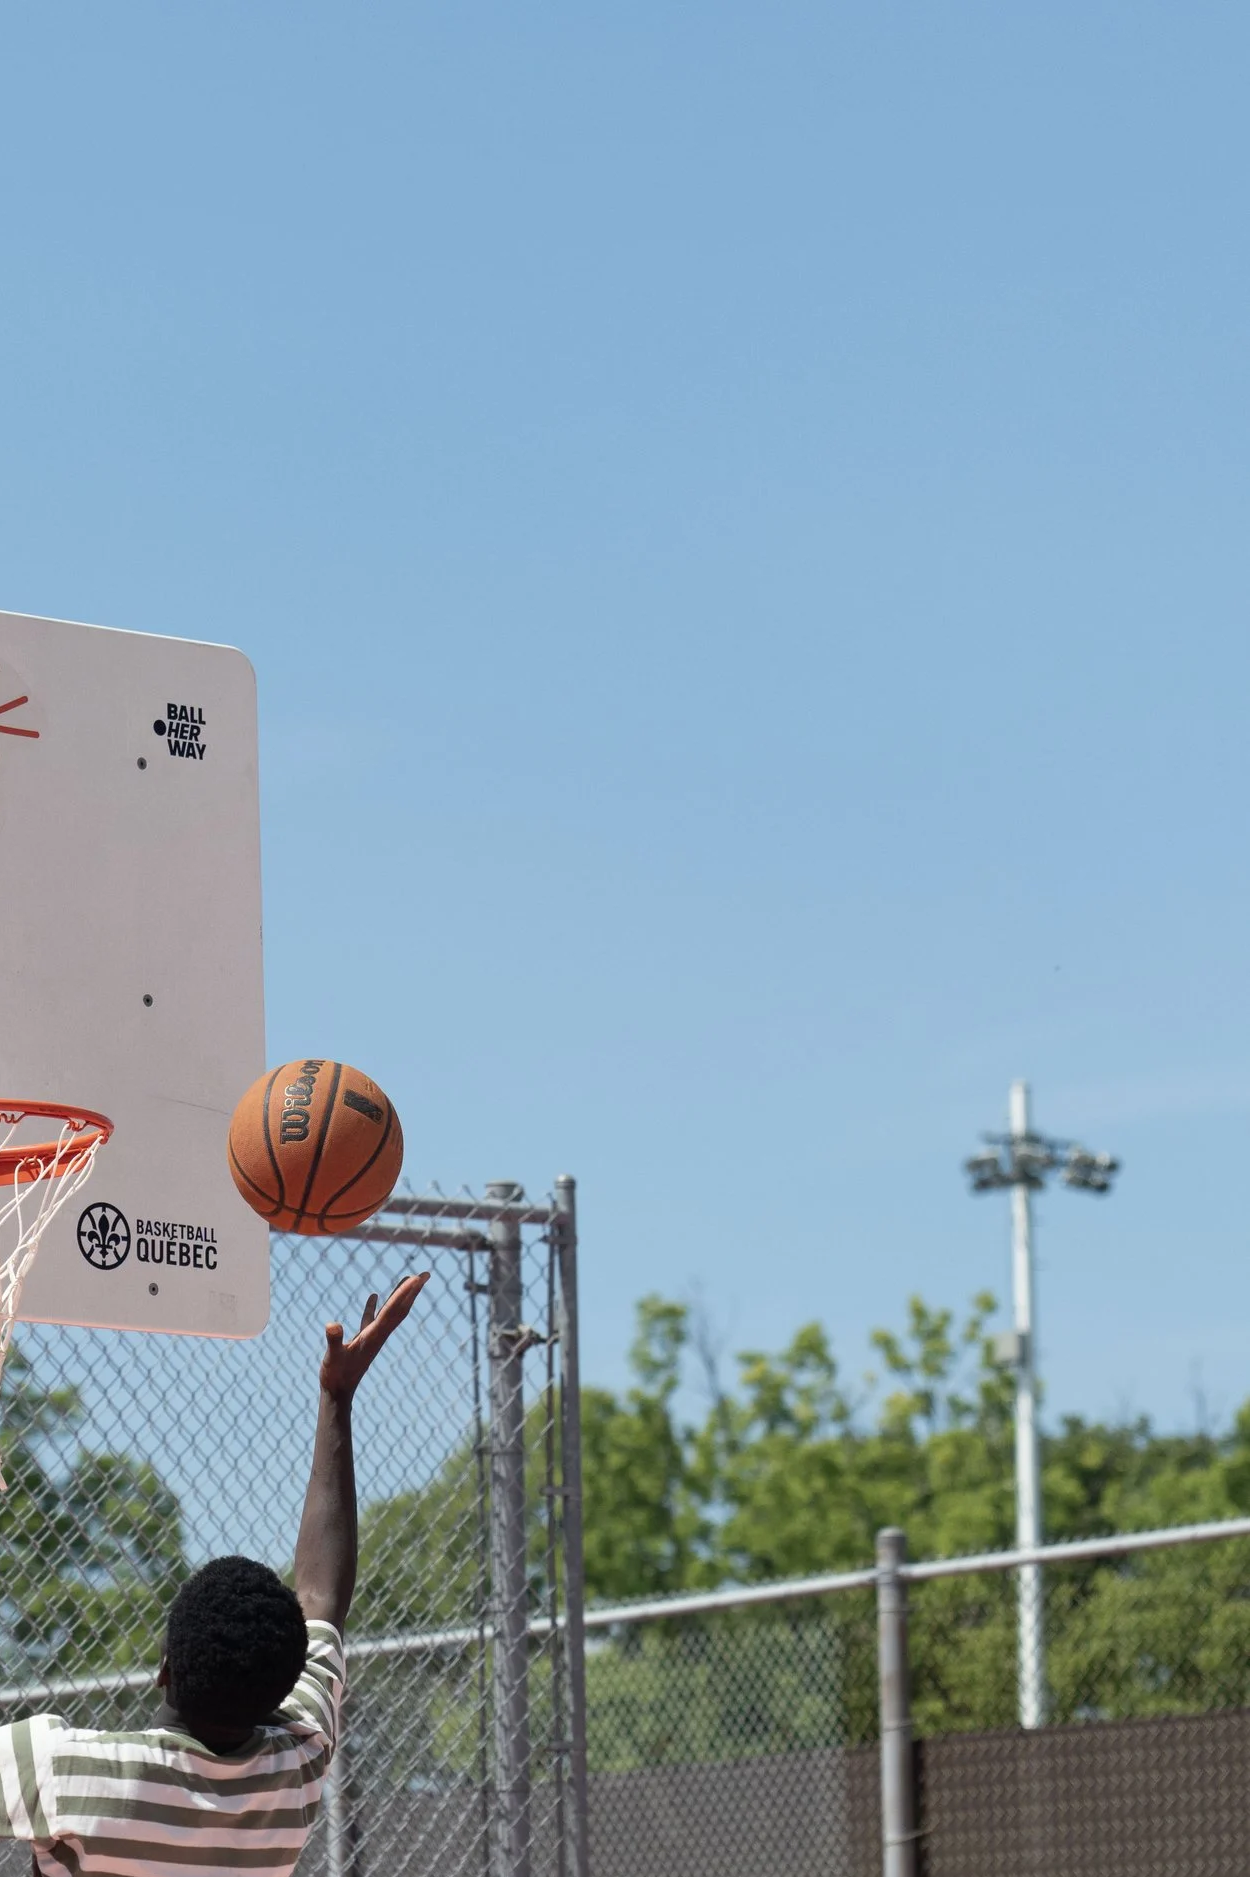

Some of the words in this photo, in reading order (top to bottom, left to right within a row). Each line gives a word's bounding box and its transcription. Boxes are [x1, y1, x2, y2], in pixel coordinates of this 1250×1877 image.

[167, 703, 206, 725] BALL
[167, 721, 201, 741] HER
[167, 739, 206, 760] WAY
[136, 1218, 218, 1244] BASKETBALL
[136, 1236, 218, 1270] QUÉBEC
